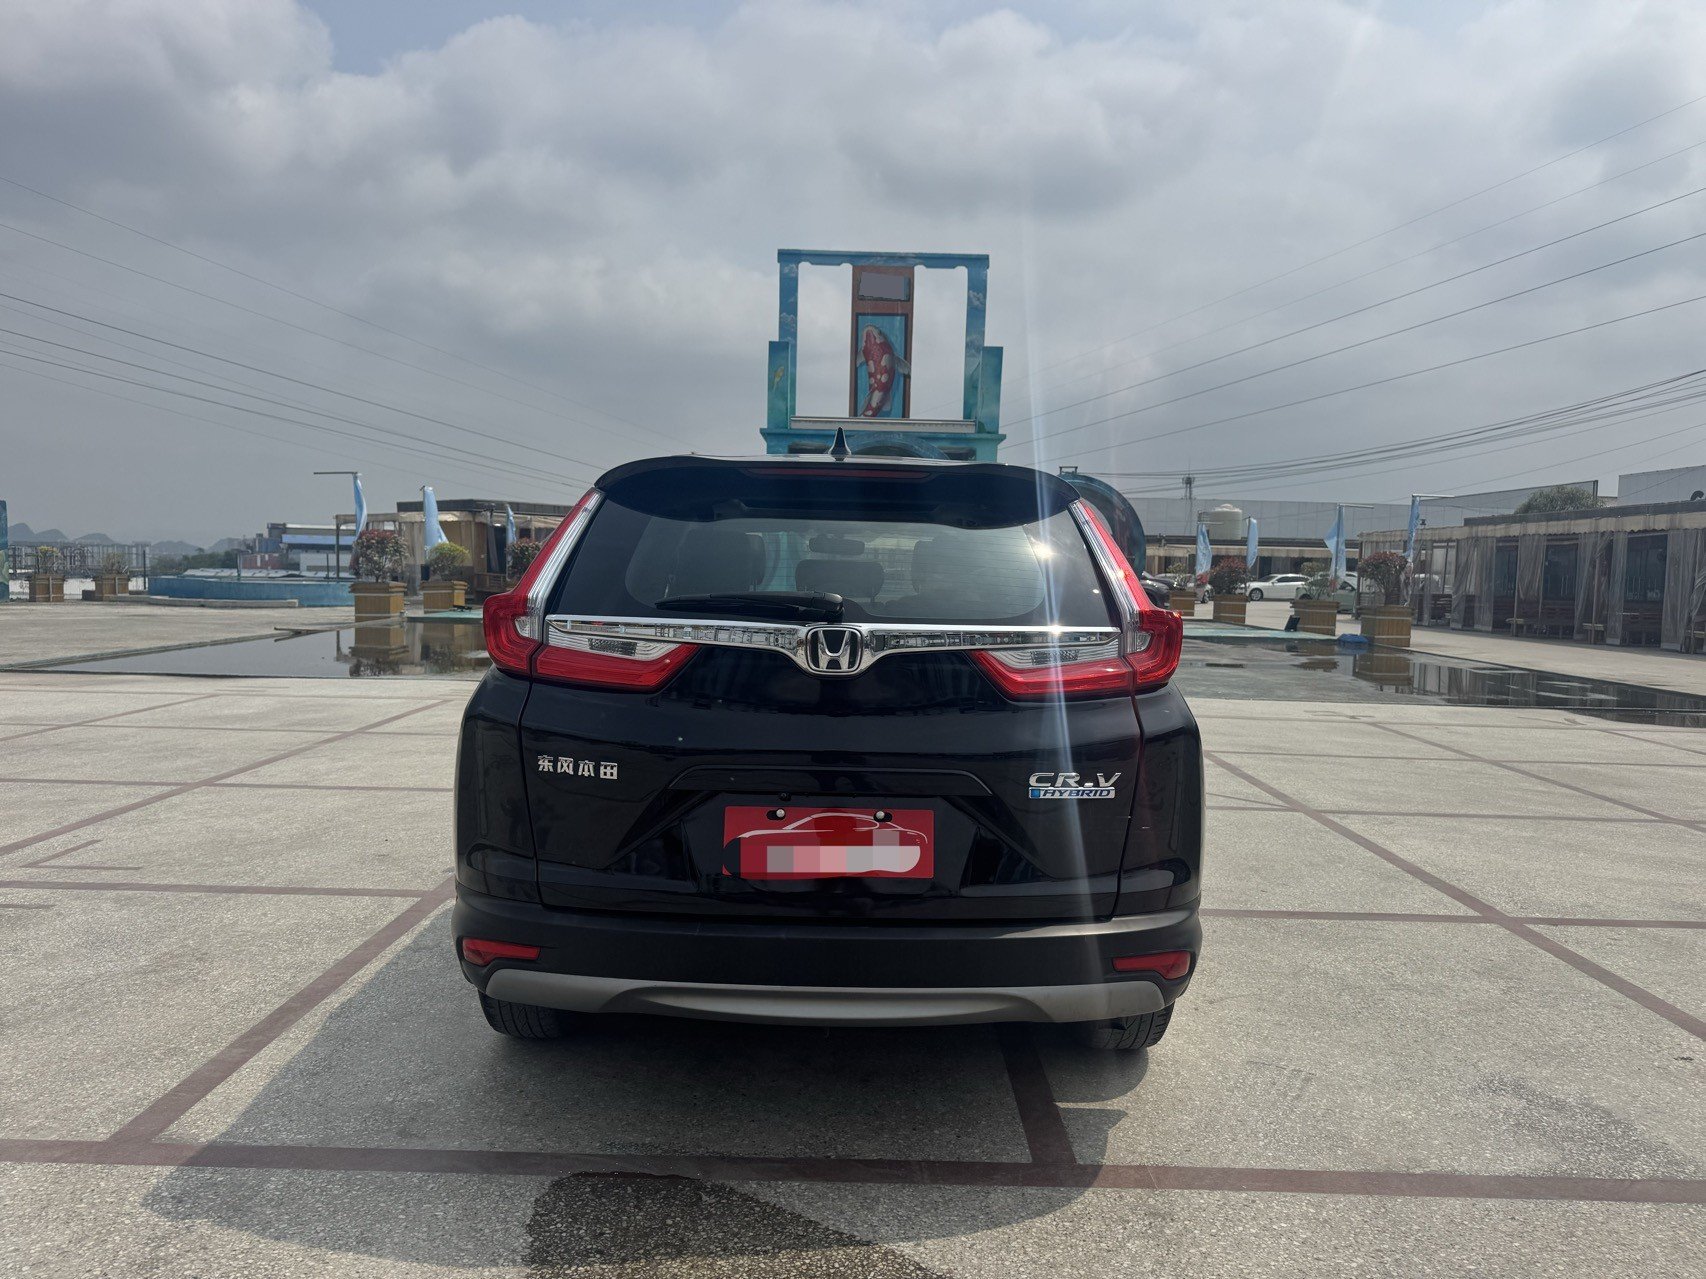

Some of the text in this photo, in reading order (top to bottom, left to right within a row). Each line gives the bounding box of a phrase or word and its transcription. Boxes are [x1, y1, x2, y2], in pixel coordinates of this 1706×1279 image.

[537, 755, 618, 780] 东风本田
[1042, 788, 1111, 798] HYBRID
